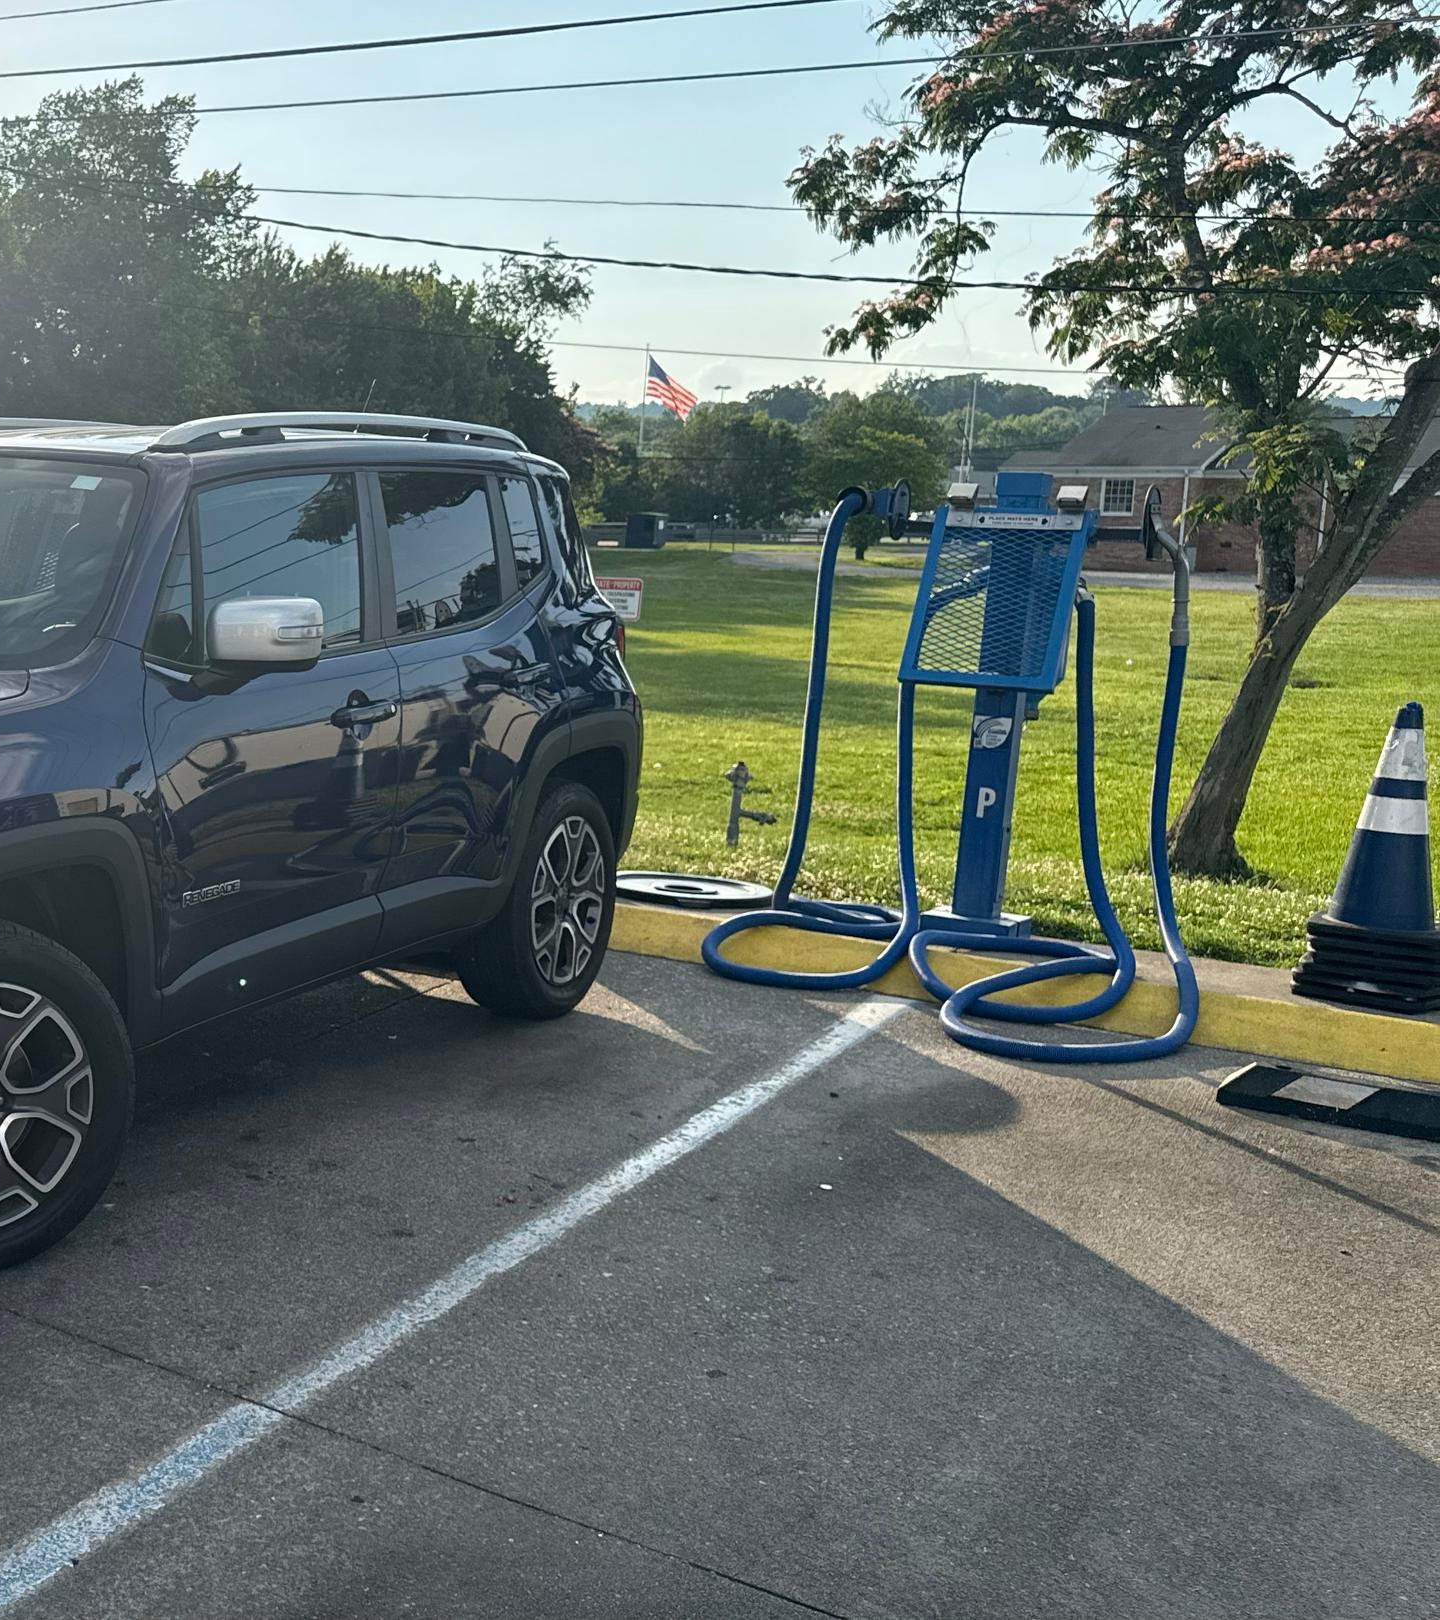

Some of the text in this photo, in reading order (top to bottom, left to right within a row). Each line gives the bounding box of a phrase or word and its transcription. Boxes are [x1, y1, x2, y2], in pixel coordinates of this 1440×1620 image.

[613, 581, 641, 590] PROPERTY
[976, 786, 997, 819] P
[182, 879, 240, 908] RENEGADE
